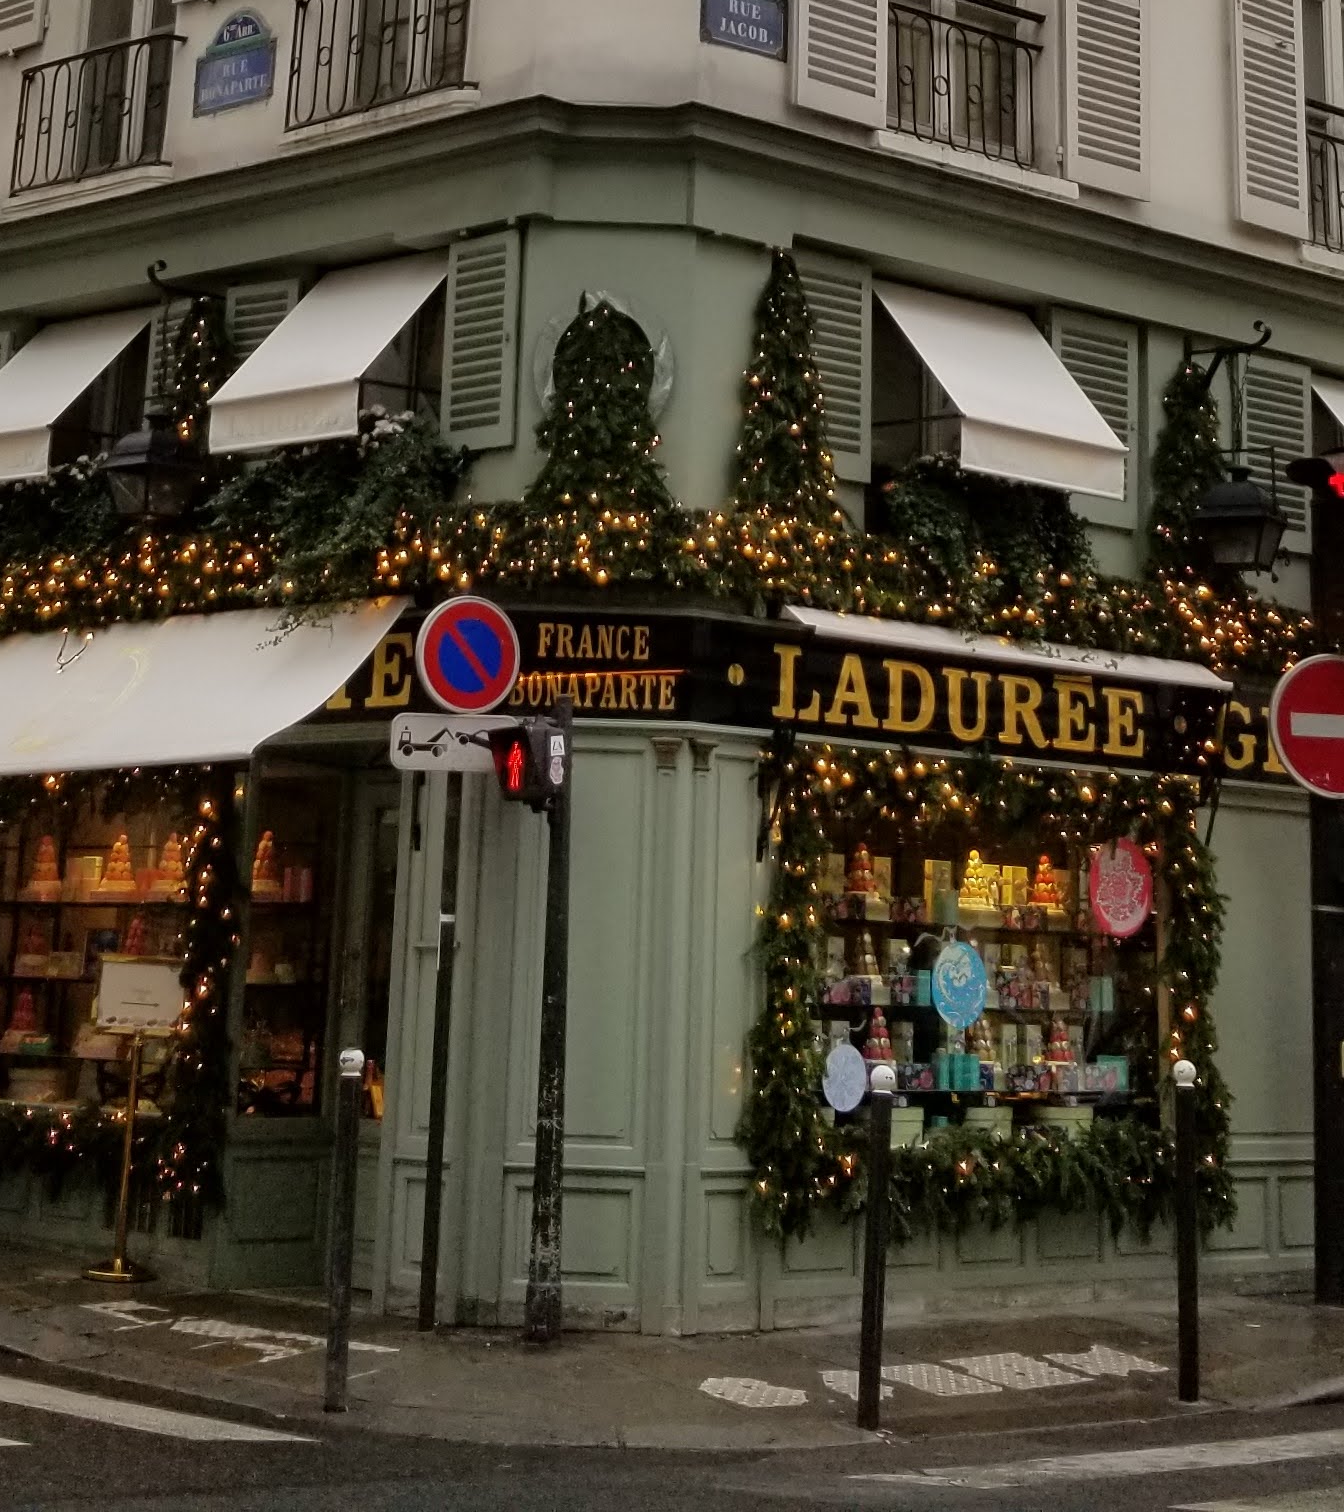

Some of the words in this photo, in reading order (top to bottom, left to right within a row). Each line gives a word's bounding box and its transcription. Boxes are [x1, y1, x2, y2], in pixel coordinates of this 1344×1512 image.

[222, 59, 249, 77] RUE
[200, 74, 267, 102] BONAPARTE
[537, 622, 650, 661] FRANCE
[508, 671, 676, 710] BONAPARTE
